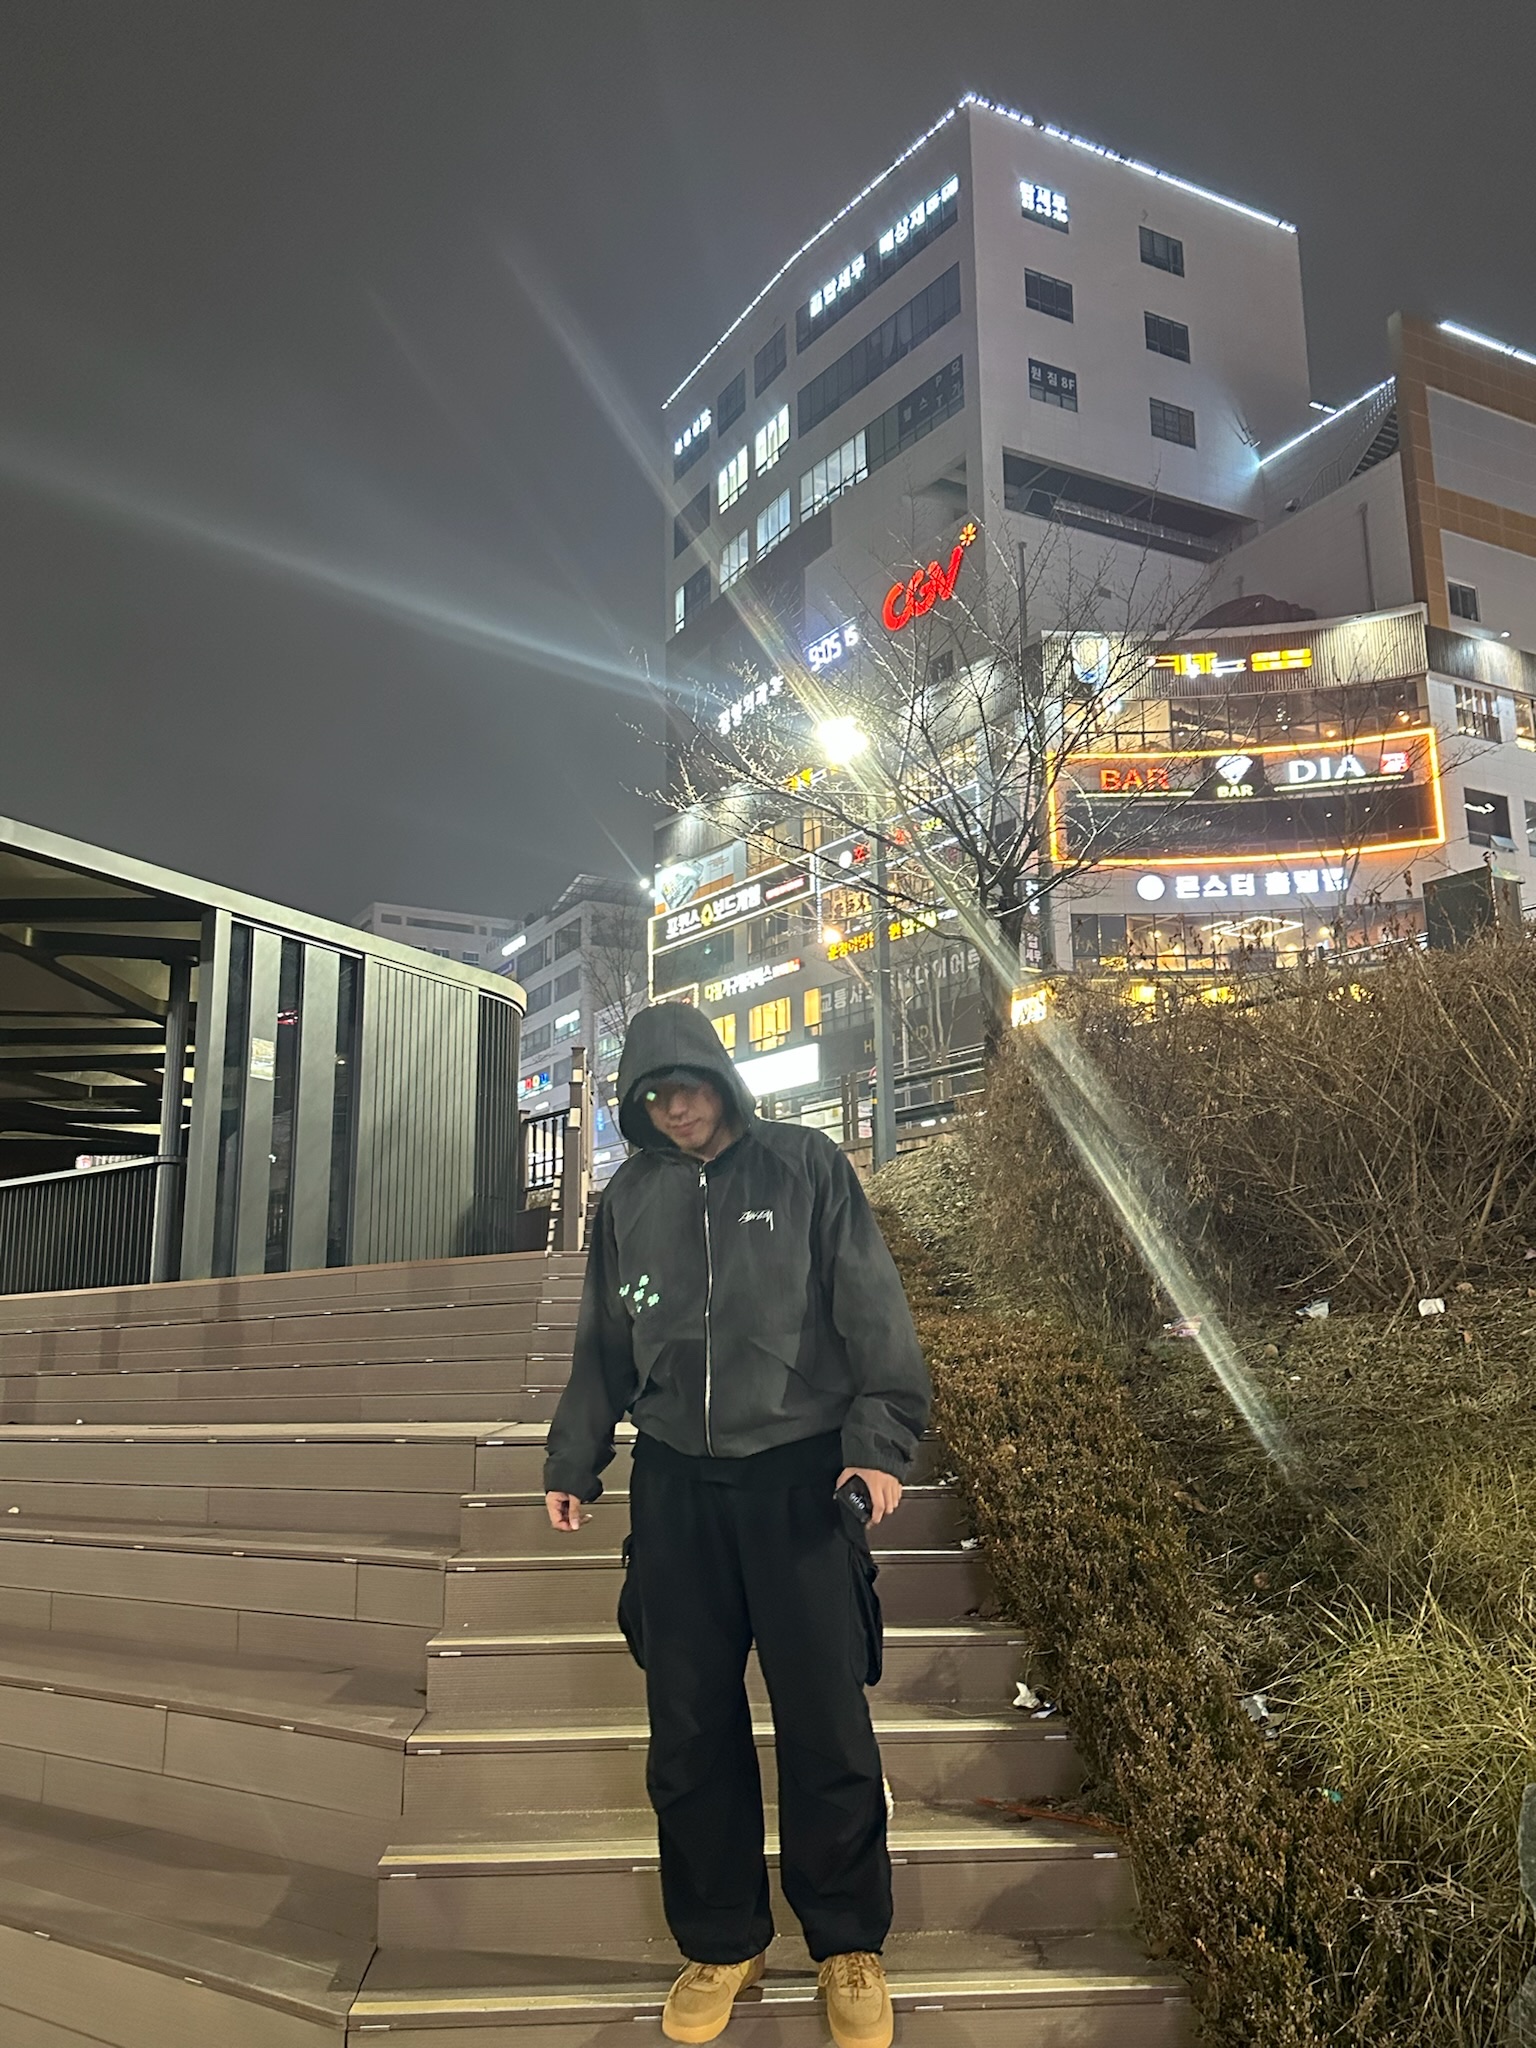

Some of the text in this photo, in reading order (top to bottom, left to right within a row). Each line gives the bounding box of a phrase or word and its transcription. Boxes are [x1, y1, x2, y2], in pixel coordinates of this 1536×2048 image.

[1061, 377, 1075, 391] 8F
[882, 545, 964, 632] CGV
[1100, 766, 1170, 792] BAR
[1287, 754, 1367, 784] DIA
[1217, 783, 1254, 798] BAR
